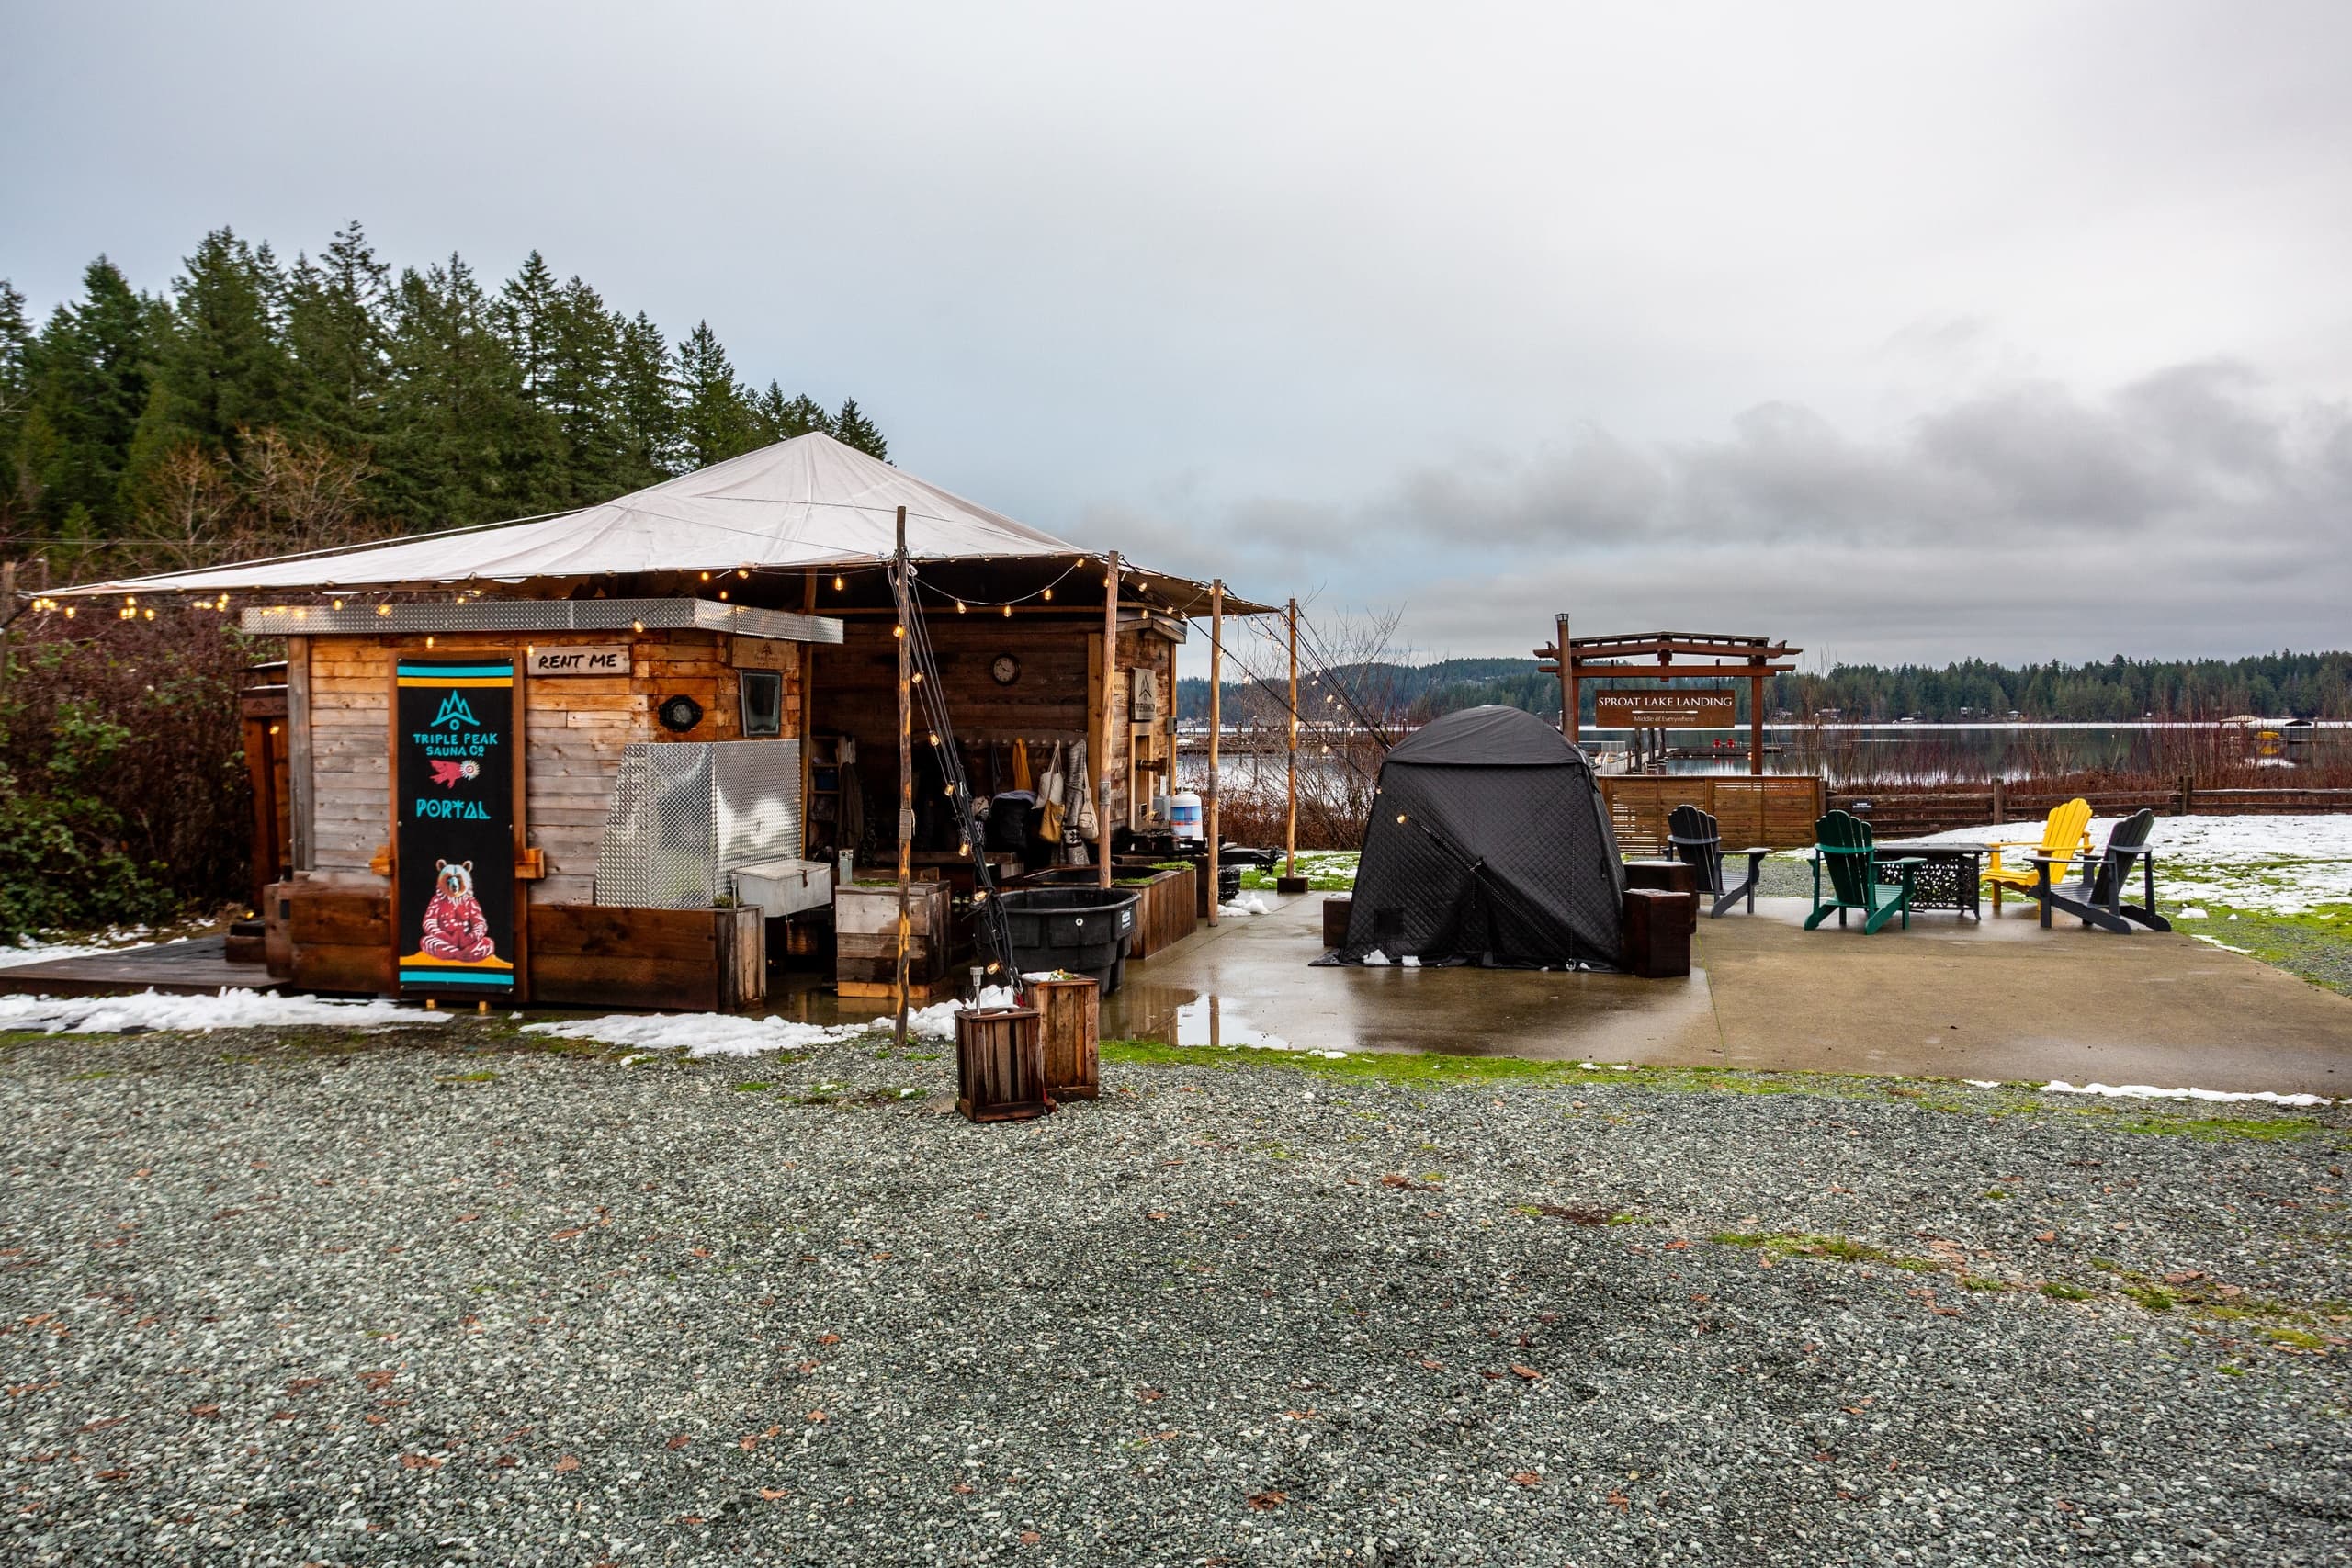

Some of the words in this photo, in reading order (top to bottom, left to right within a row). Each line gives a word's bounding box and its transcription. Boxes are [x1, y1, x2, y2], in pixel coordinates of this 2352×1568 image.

[538, 655, 585, 669] RENT
[589, 653, 617, 668] ME
[1598, 697, 1641, 706] SPROAT
[1645, 697, 1674, 706] LAKE
[1677, 697, 1733, 706] LANDING
[413, 734, 458, 745] TRIPLE
[464, 733, 498, 745] PEAK
[425, 746, 467, 757] SAUNA
[416, 798, 492, 819] PORTAL
